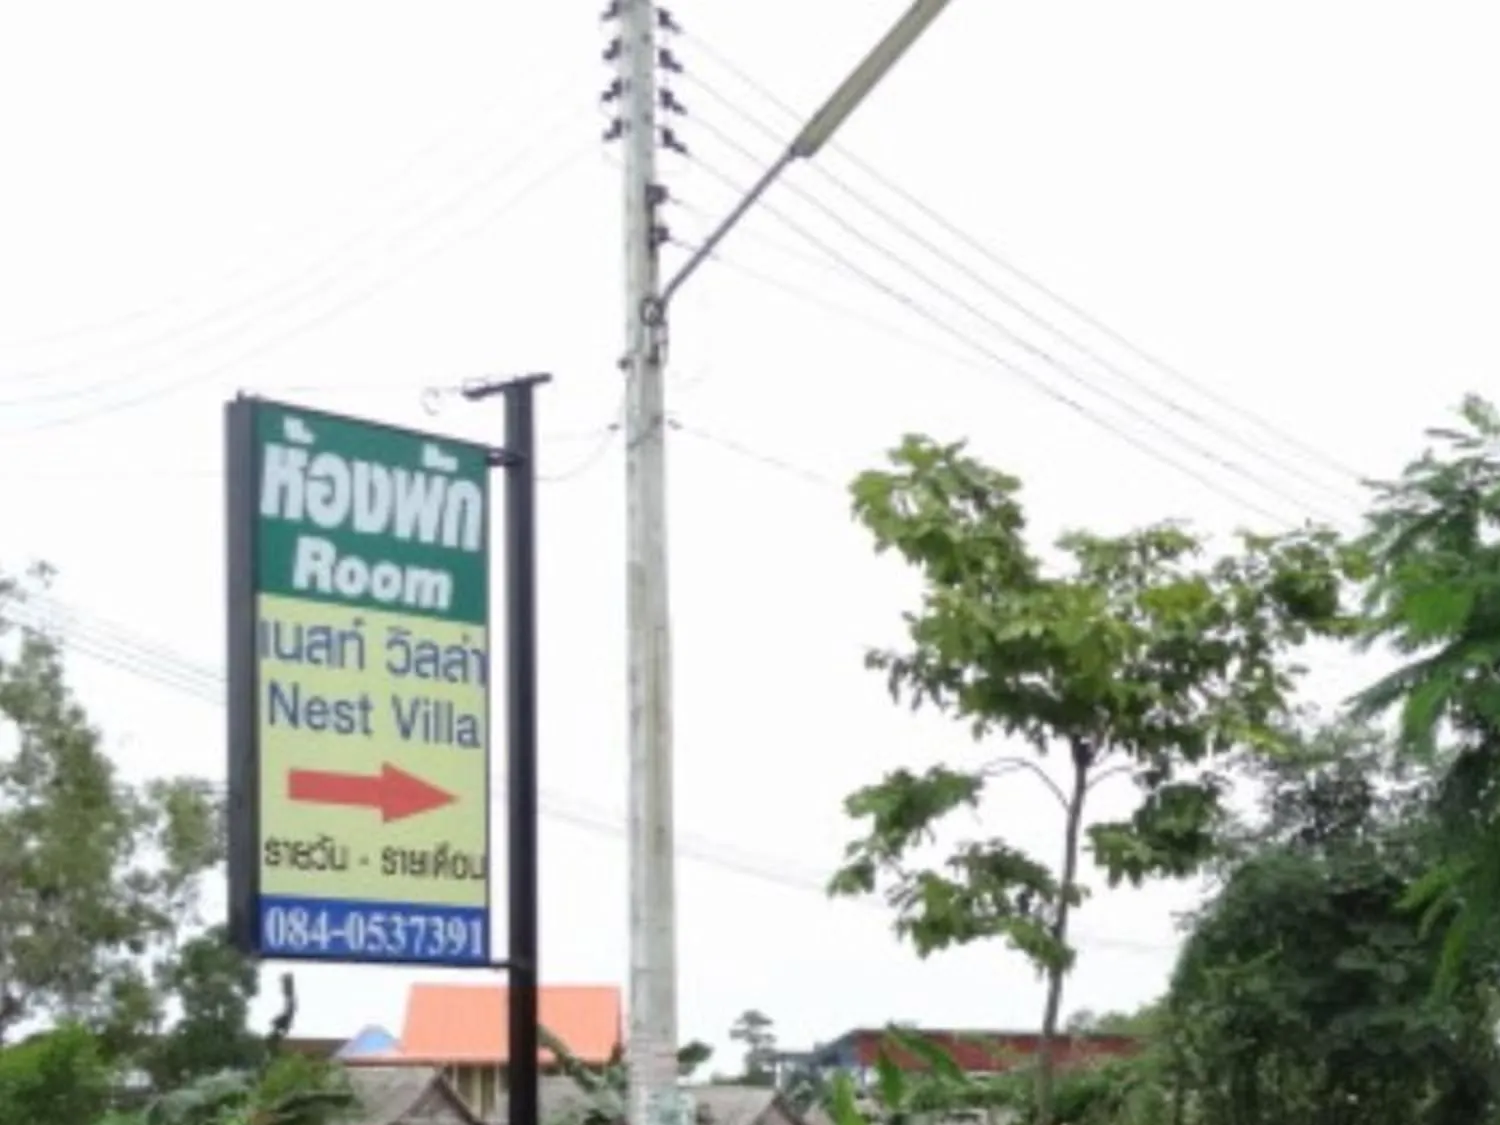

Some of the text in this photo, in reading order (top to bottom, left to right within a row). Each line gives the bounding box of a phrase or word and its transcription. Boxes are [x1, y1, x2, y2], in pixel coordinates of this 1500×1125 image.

[260, 415, 482, 551] ห้องพัก
[292, 536, 453, 610] Room
[257, 617, 489, 686] เนสท์ วิลล่า
[268, 679, 481, 749] Nest Villa
[265, 906, 483, 956] 084-0537391
